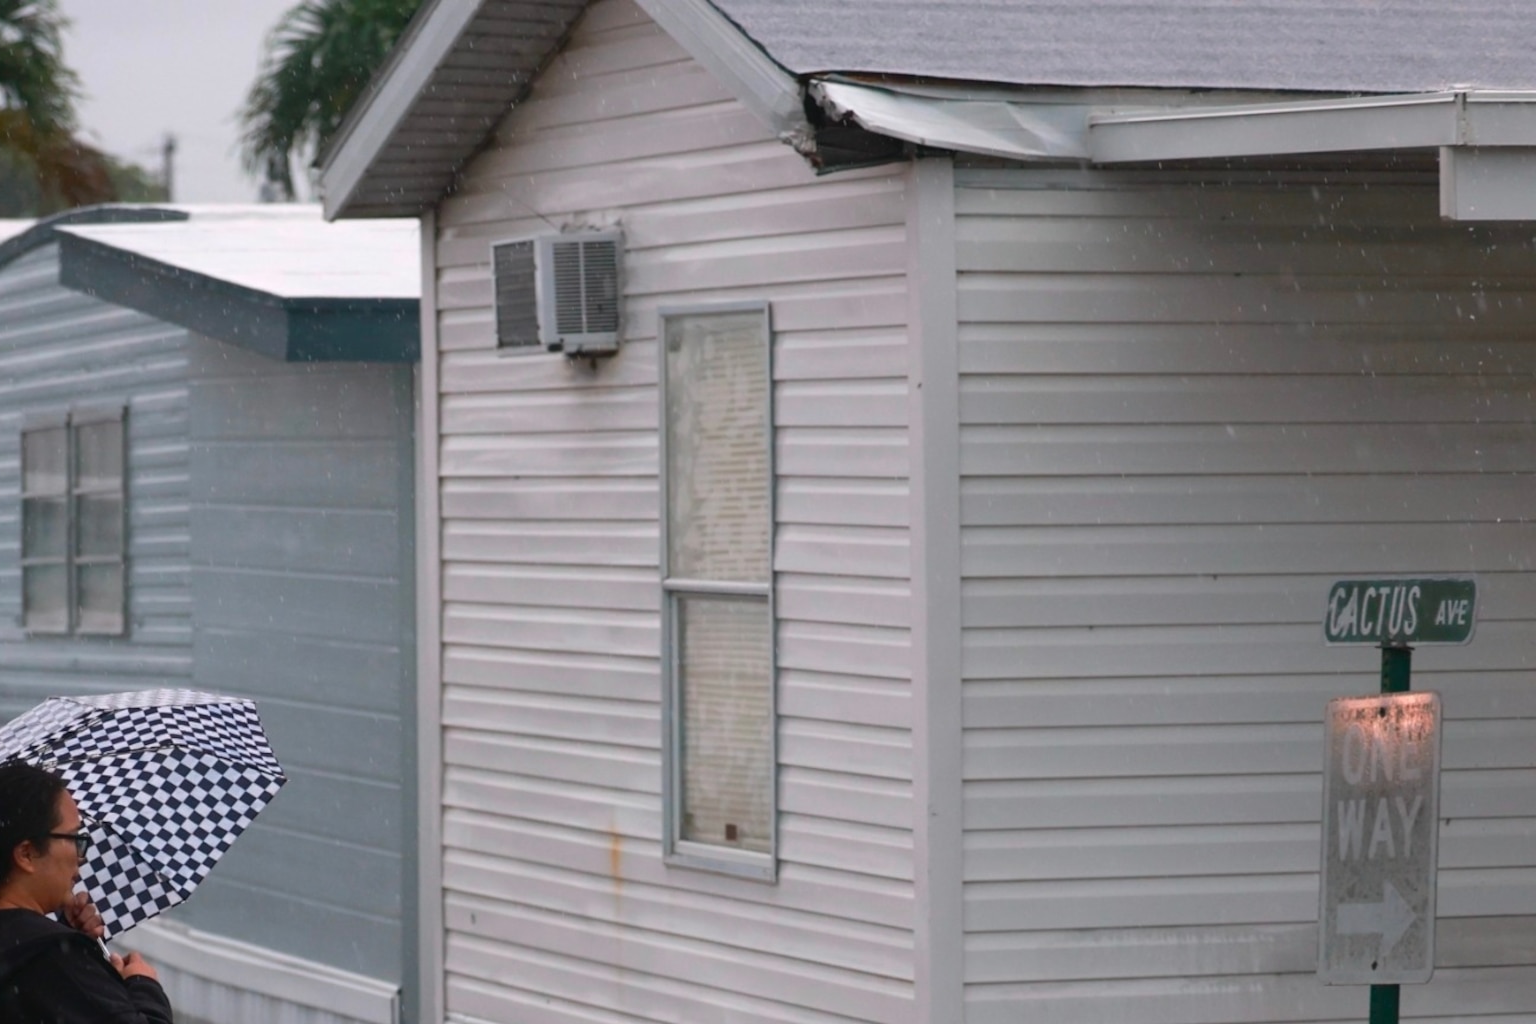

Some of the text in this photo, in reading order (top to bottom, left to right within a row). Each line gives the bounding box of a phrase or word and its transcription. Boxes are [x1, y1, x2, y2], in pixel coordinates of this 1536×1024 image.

[1329, 584, 1469, 638] CACTUS AVE
[1341, 719, 1422, 785] ONE
[1337, 794, 1424, 862] WAY
